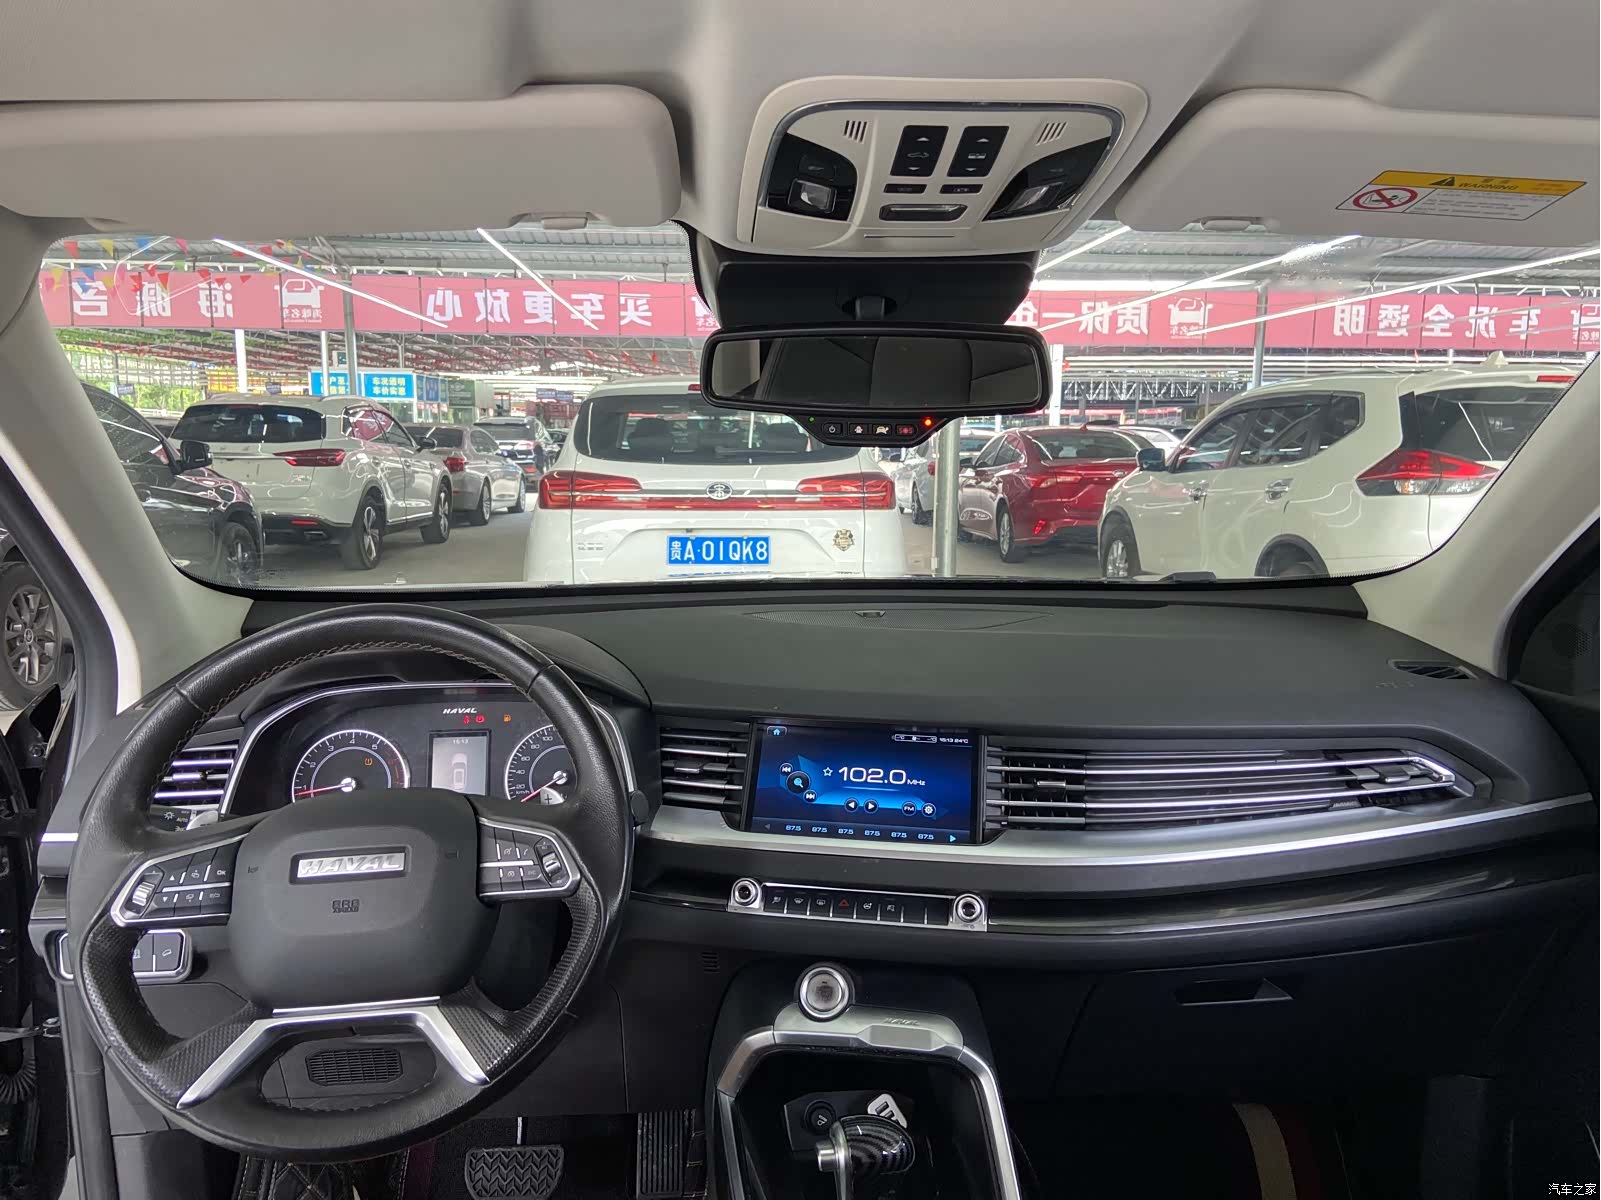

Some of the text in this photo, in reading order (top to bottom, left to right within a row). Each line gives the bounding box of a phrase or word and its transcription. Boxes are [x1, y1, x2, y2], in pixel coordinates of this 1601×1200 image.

[1458, 182, 1518, 191] WARNING
[443, 707, 478, 715] HAVAL
[838, 766, 907, 785] 102.0
[300, 854, 401, 874] HAVAL
